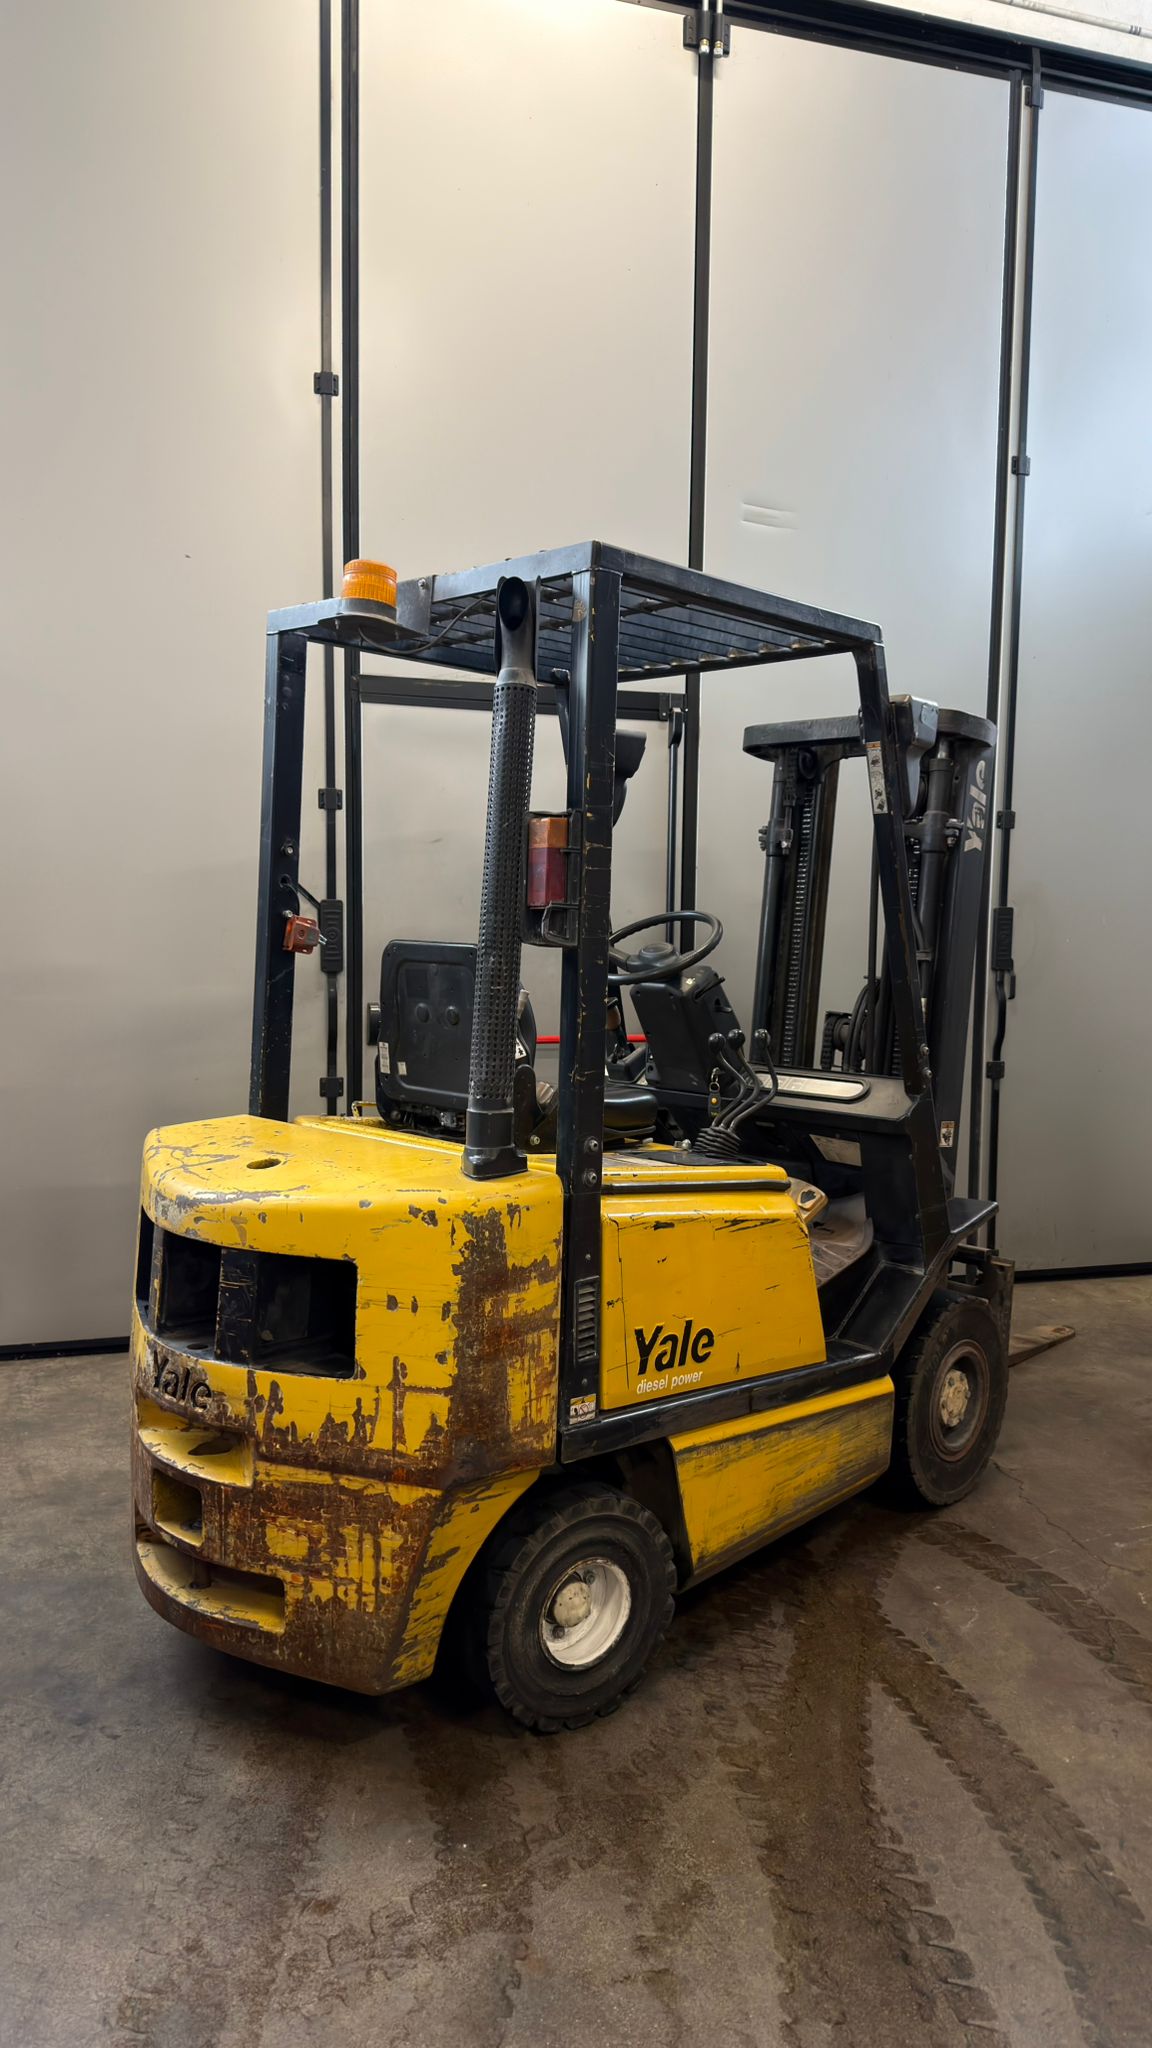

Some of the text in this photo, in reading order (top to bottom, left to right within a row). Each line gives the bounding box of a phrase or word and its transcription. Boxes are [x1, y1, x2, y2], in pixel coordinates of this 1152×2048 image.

[963, 760, 987, 852] Yale
[634, 1319, 715, 1376] Yale
[153, 1349, 213, 1411] Yale
[637, 1371, 703, 1395] diesel power
